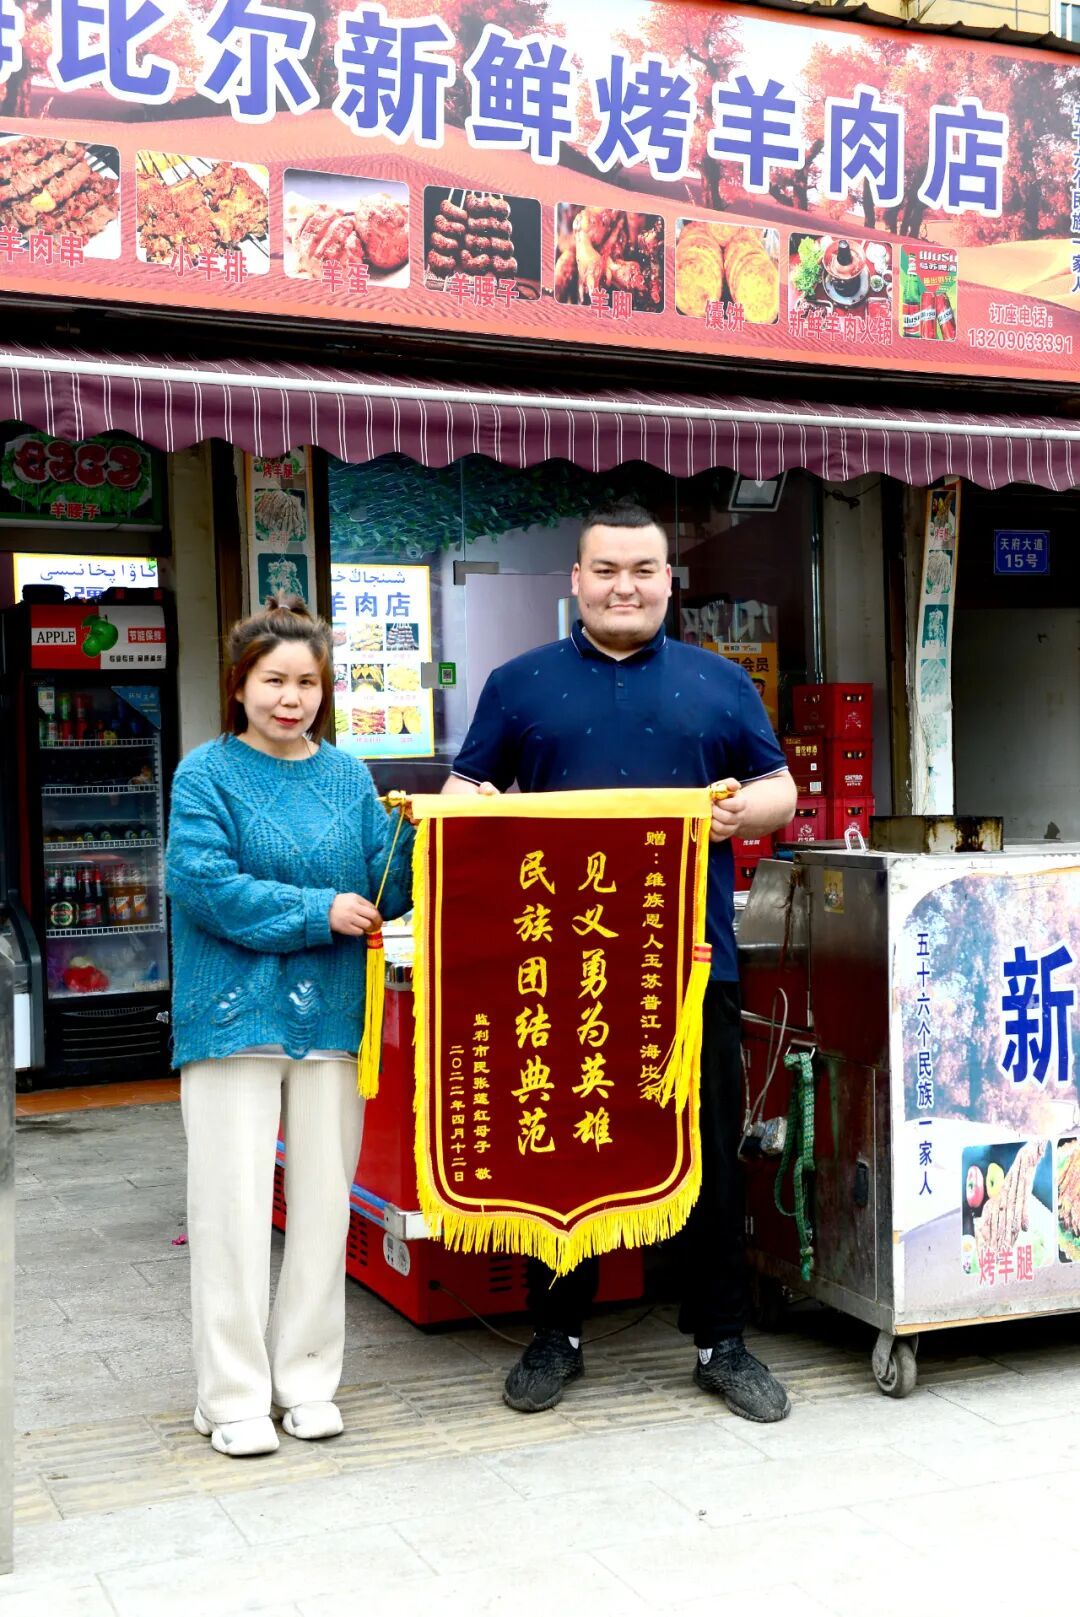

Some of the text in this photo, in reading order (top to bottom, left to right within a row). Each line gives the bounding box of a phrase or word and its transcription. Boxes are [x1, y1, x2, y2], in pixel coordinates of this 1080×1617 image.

[0, 226, 84, 267] 羊肉串
[170, 247, 248, 283] 小羊排
[322, 260, 371, 296] 羊蛋
[451, 273, 520, 308] 羊腰子
[591, 288, 633, 320] 羊脚
[704, 299, 746, 332] 馕饼
[788, 307, 894, 345] 新鲜羊肉火锅
[967, 327, 1073, 354] 13209033391
[50, 501, 99, 520] 羊腰子
[1000, 537, 1044, 551] 天府大道
[1004, 553, 1038, 568] 15号
[36, 631, 76, 644] APPLE
[510, 848, 556, 1156] 民族团结典范
[571, 851, 619, 1152] 见义勇为英雄
[1001, 943, 1076, 1085] 新
[916, 932, 933, 1196] 五十六个民族一家人
[977, 1243, 1034, 1287] 烤羊腿
